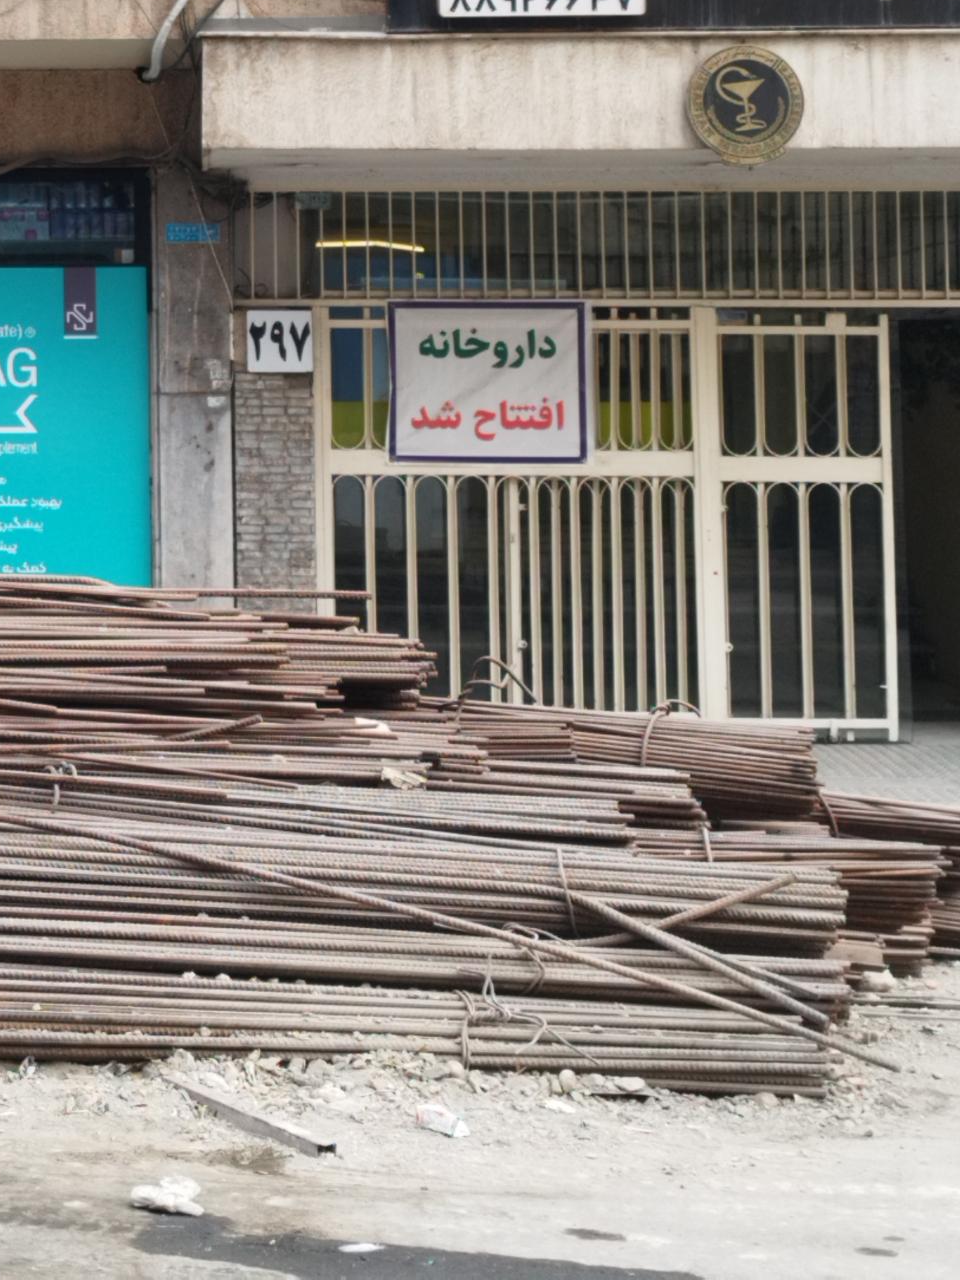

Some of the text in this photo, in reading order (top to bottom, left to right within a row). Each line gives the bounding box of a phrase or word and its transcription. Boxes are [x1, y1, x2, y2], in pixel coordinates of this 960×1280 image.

[249, 321, 311, 361] ۲۹۷
[418, 328, 557, 369] داروخانه
[411, 396, 565, 442] افتتاح شد
